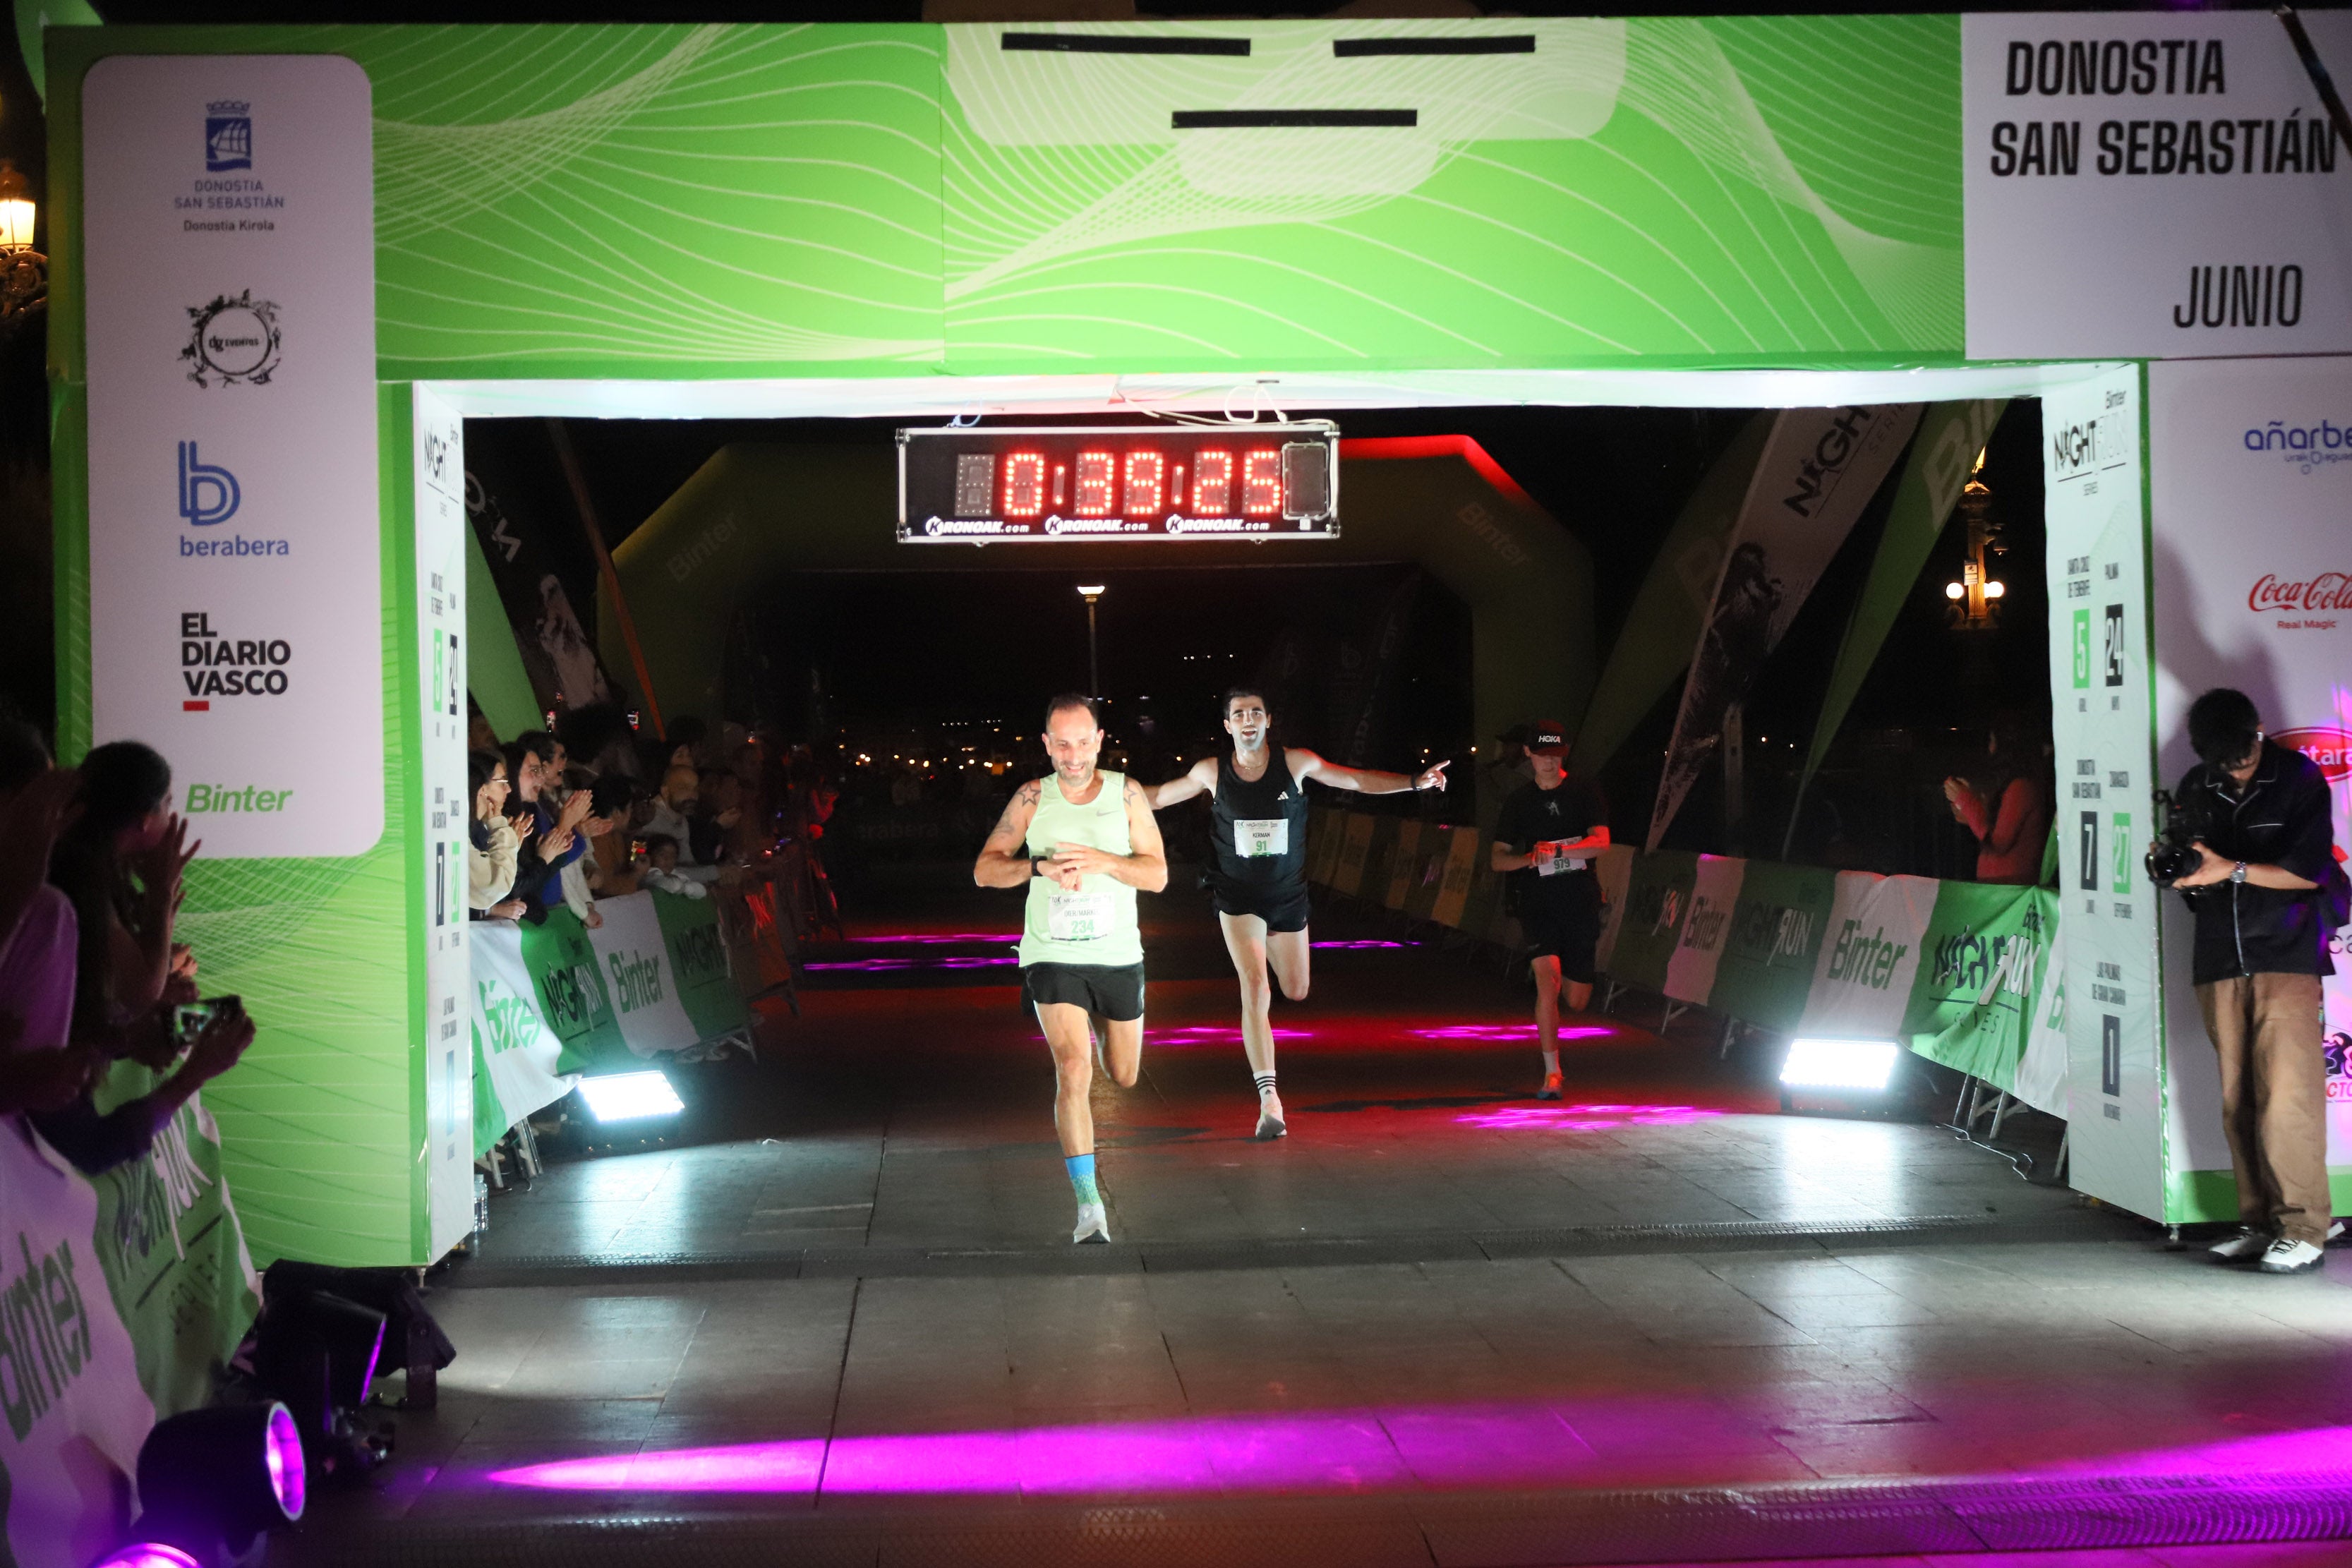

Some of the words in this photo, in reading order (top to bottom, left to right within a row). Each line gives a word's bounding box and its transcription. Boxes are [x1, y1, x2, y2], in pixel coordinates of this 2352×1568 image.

[2006, 40, 2225, 95] DONOSTIA
[1990, 121, 2080, 176] SAN
[2097, 107, 2337, 175] SEBASTIÁN
[195, 180, 263, 192] DONOSTIA
[175, 197, 203, 209] SAN
[207, 195, 284, 209] SEBASTIÁN
[183, 220, 235, 231] Donostia
[239, 220, 275, 231] Kirola
[2173, 264, 2303, 328] JUNIO
[225, 338, 259, 347] EVENTOS
[1006, 452, 1281, 514] 0:39:25
[180, 535, 289, 556] berabera
[181, 613, 217, 638] EL
[2277, 620, 2300, 629] Real
[2305, 620, 2336, 629] Magic
[182, 640, 291, 666] DIARIO
[2077, 622, 2086, 680] 5
[2106, 617, 2123, 676] 24
[183, 670, 289, 696] VASCO
[185, 784, 293, 813] Binter
[1256, 840, 1267, 851] 91
[2085, 824, 2093, 880] 7
[2113, 825, 2130, 883] 27
[1553, 858, 1571, 869] 979
[1064, 909, 1101, 917] OIER/MARKE
[1071, 919, 1094, 934] 234
[1828, 919, 1907, 990] Binter
[608, 948, 663, 1014] Binter
